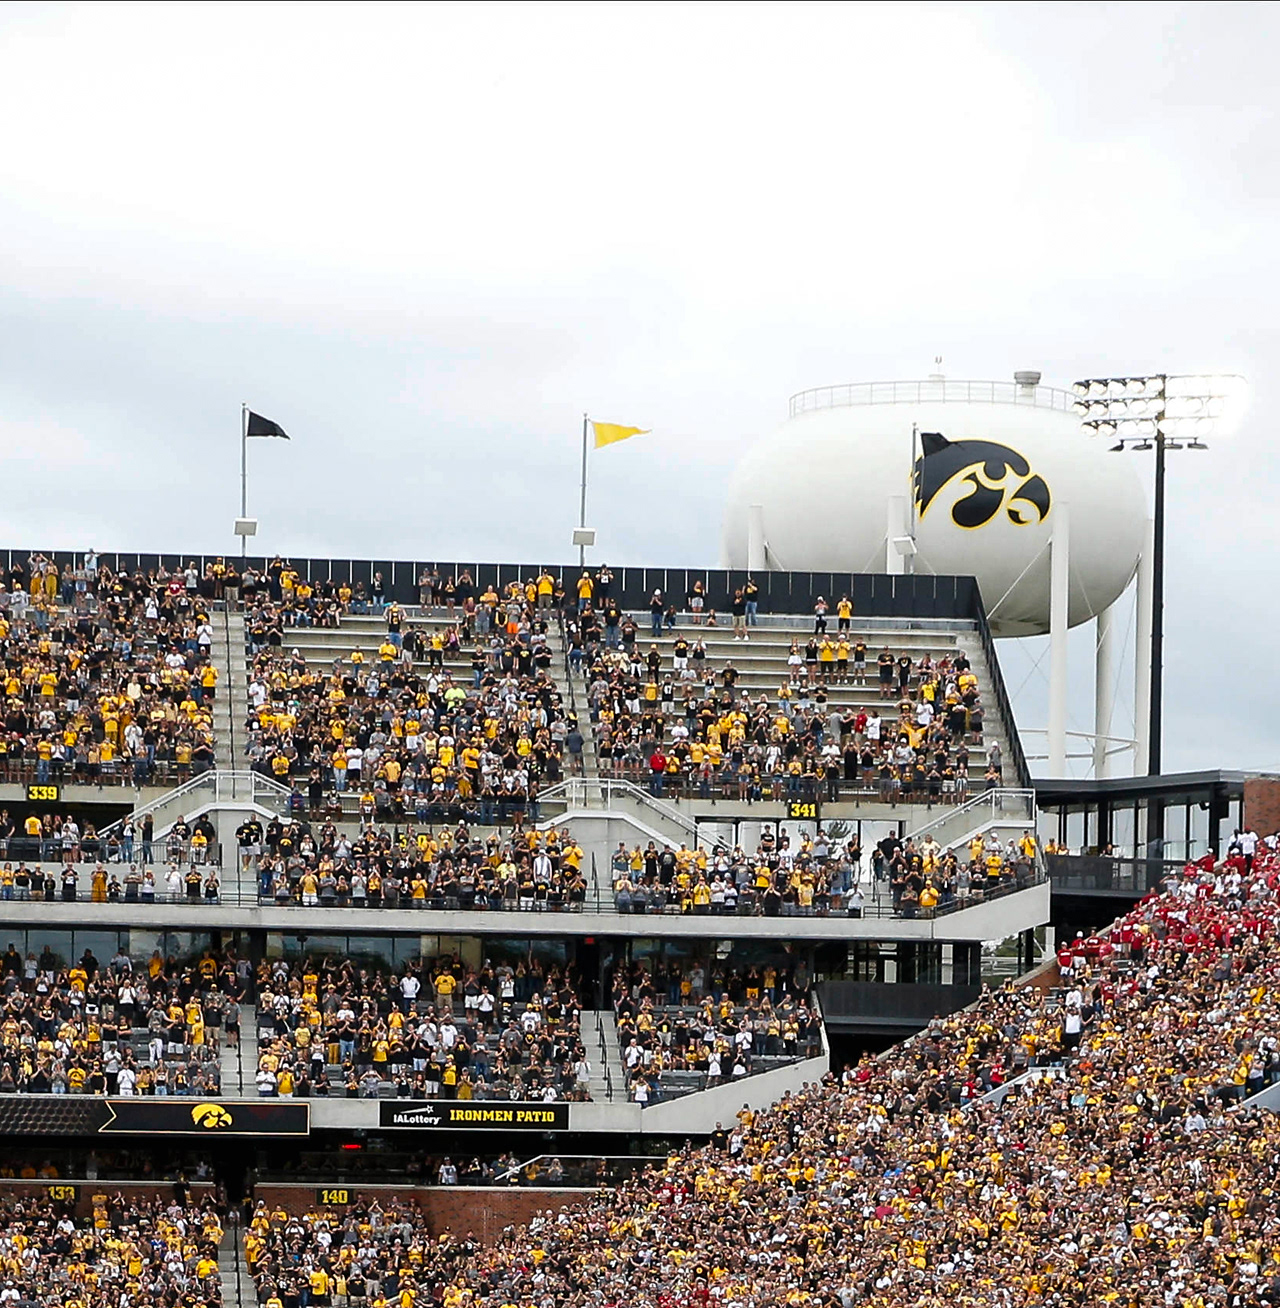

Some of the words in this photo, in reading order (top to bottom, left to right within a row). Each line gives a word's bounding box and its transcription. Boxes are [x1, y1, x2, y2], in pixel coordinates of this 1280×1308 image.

[29, 786, 58, 800] 339
[791, 803, 817, 817] 341
[399, 834, 428, 848] 30
[394, 1114, 441, 1125] IALottery
[450, 1110, 513, 1122] IRONMEN
[516, 1110, 555, 1123] PATIO
[322, 1190, 348, 1203] 140
